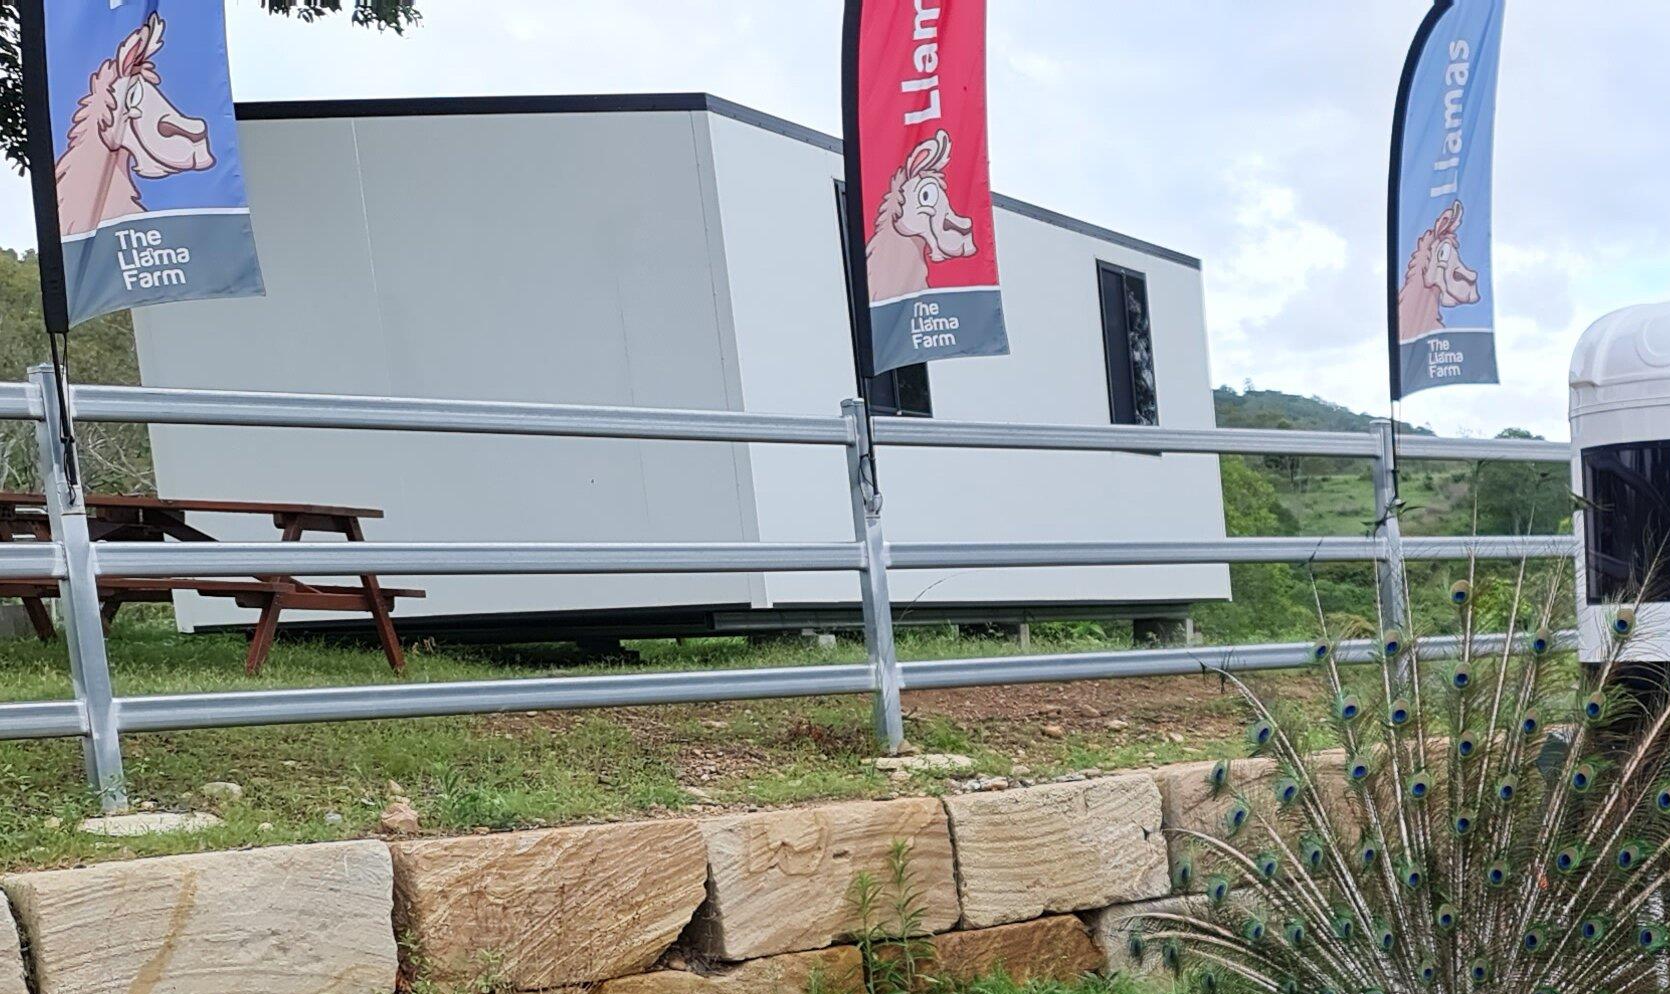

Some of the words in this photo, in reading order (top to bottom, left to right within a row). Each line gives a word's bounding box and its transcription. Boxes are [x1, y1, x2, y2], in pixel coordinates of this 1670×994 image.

[1430, 39, 1470, 198] Llamas
[114, 229, 162, 250] The
[117, 248, 191, 270] Llama
[123, 269, 186, 291] Farm
[914, 301, 940, 317] The
[911, 317, 960, 334] Llama
[912, 333, 957, 349] Farm
[1427, 339, 1450, 351] The
[1428, 352, 1464, 365] Llama
[1429, 365, 1461, 378] Farm
